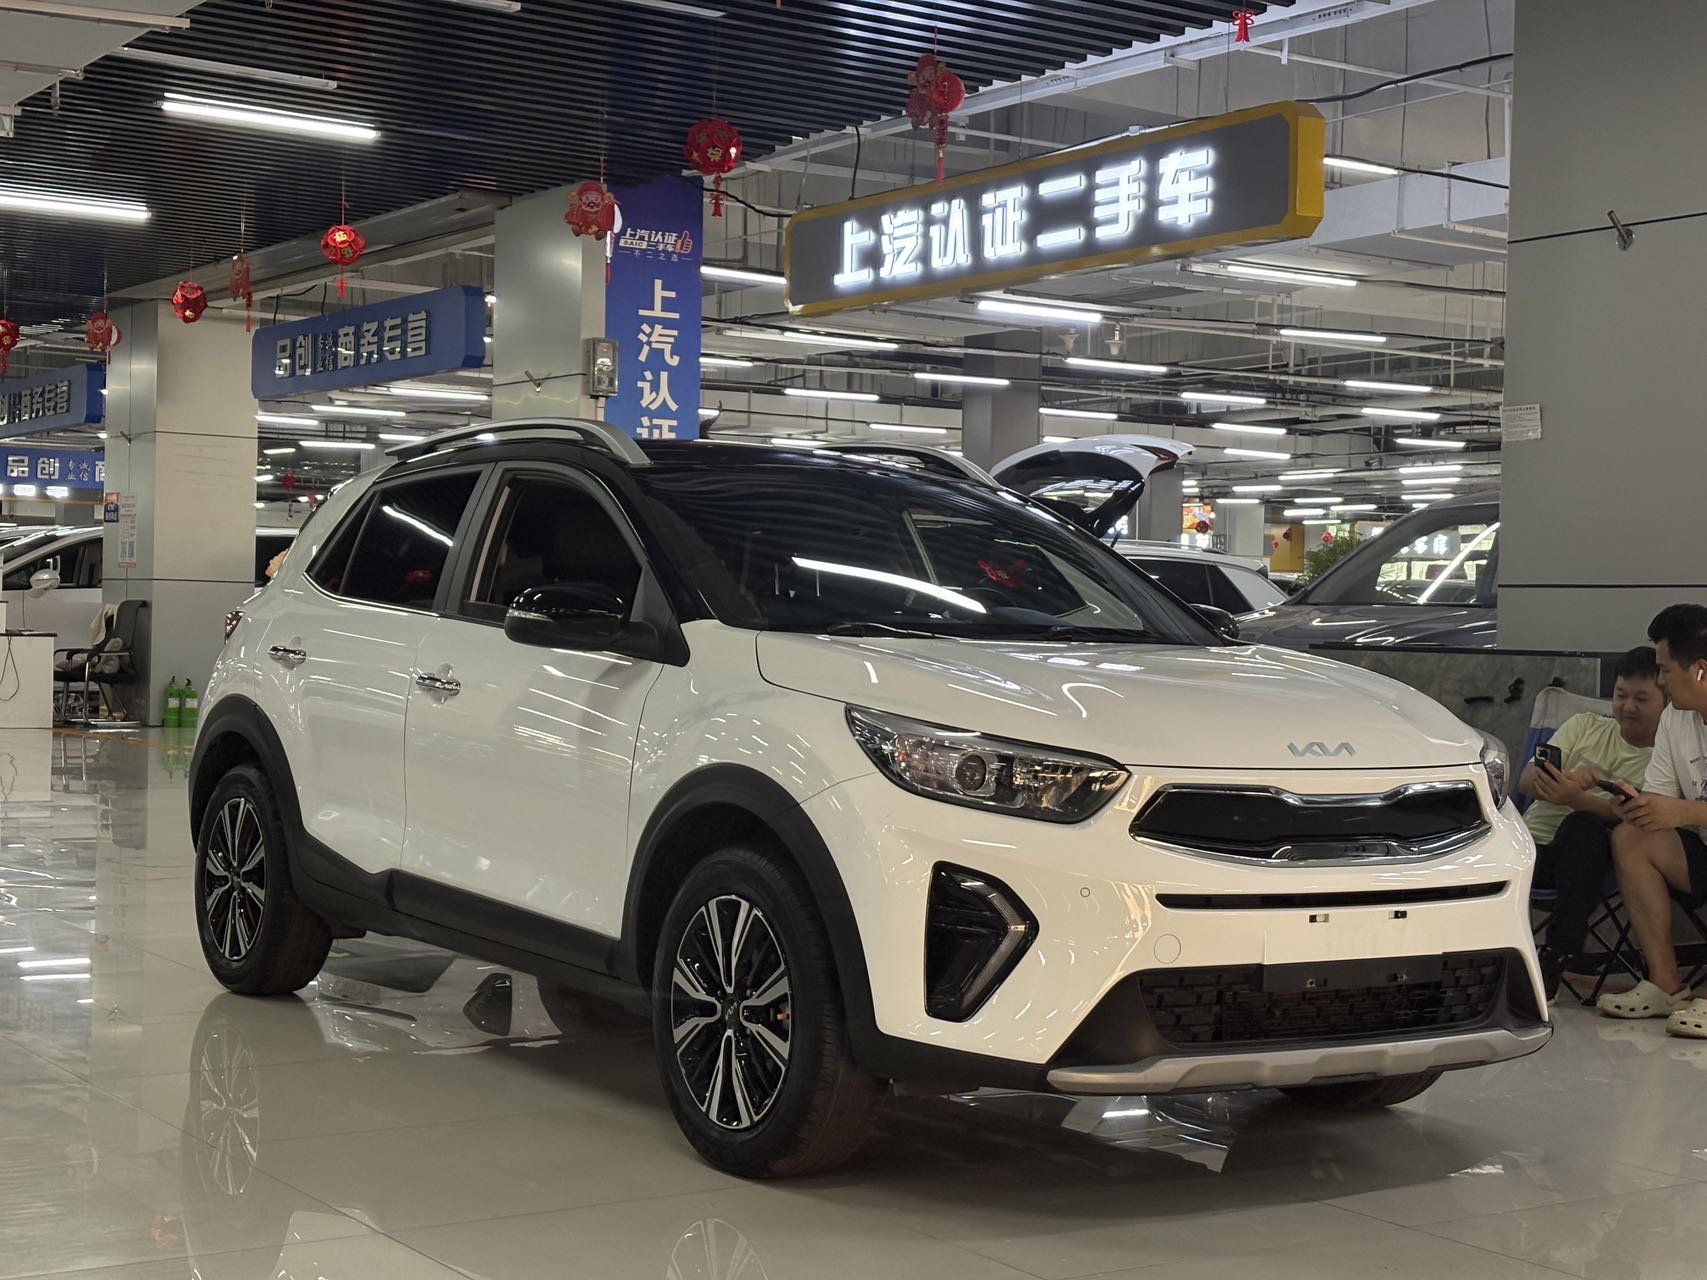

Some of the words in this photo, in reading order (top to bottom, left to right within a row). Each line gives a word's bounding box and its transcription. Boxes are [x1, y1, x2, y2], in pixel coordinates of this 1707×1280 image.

[833, 148, 1213, 287] 上汽认证二手车
[621, 228, 678, 243] 上汽认证
[623, 240, 645, 248] SAIC
[647, 242, 677, 252] 二手车
[275, 333, 312, 379] 品创
[7, 455, 60, 480] 品创
